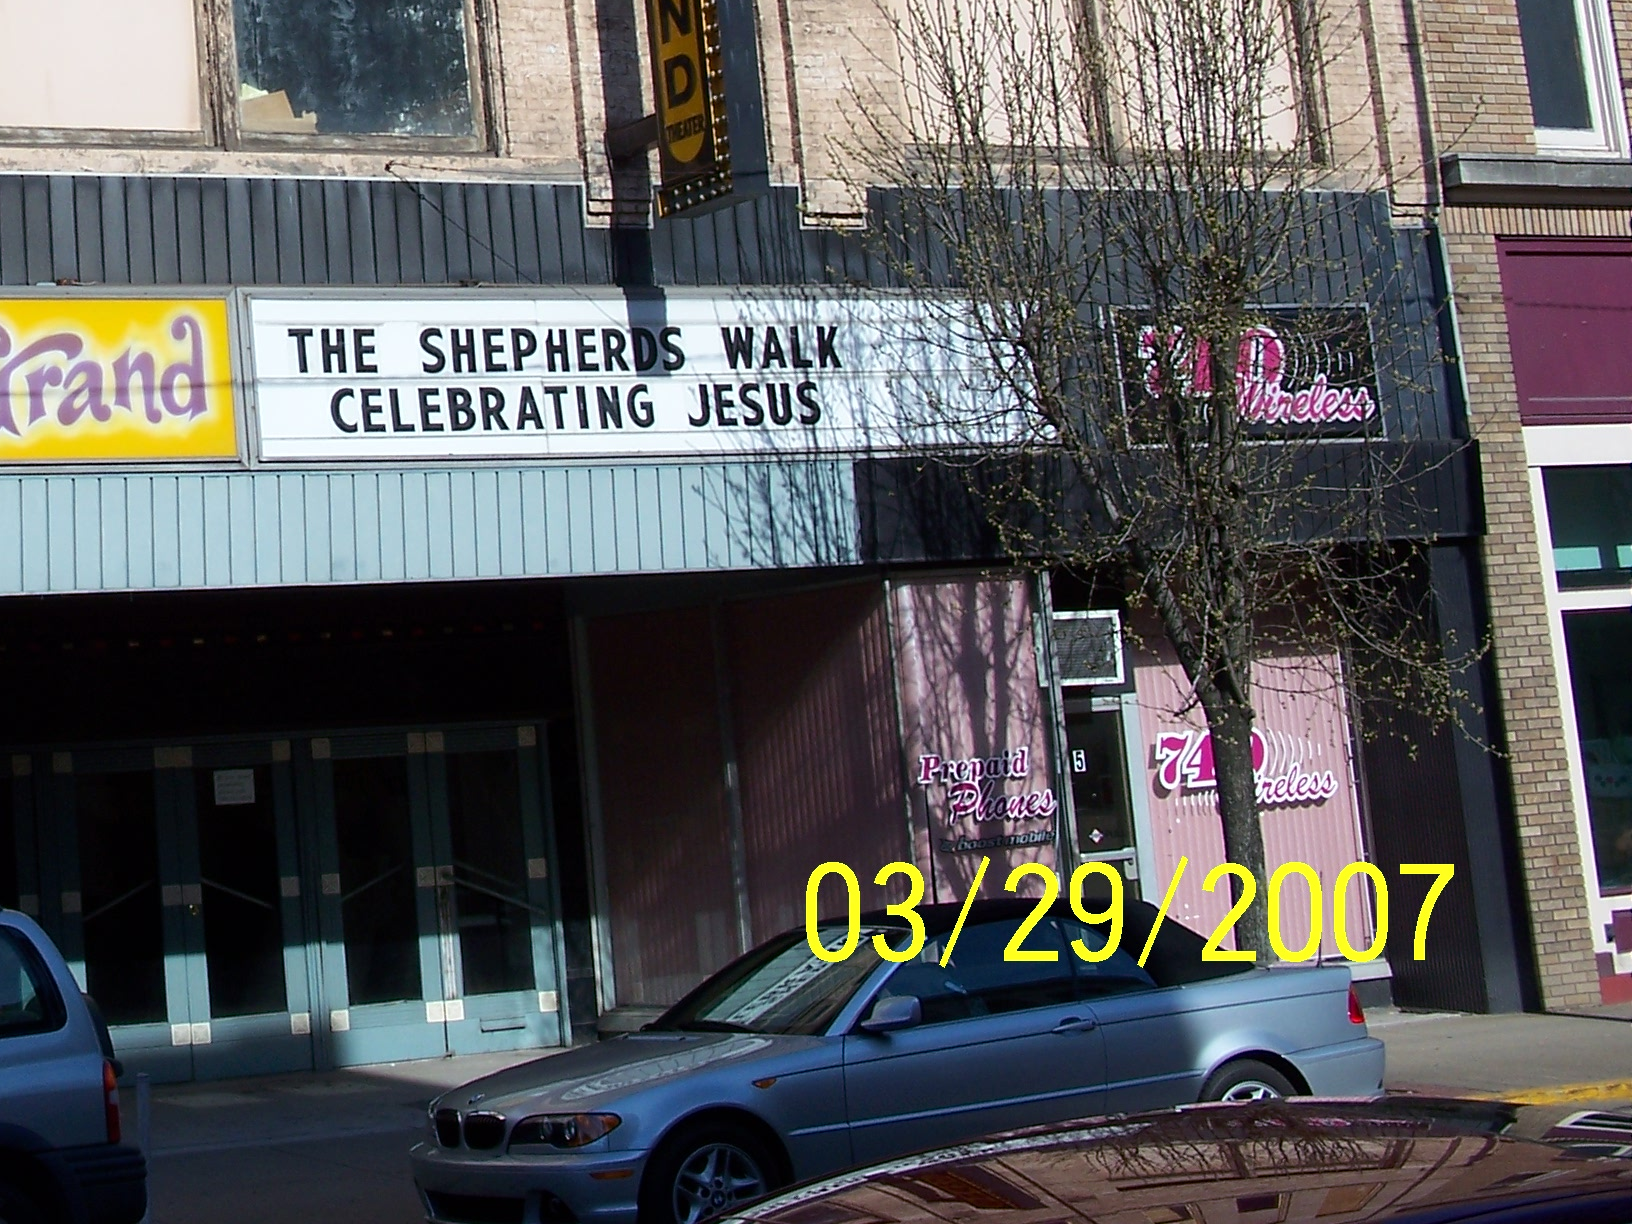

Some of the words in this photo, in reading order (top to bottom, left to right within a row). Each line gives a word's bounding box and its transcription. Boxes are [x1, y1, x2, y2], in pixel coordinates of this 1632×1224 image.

[287, 327, 378, 374] THE
[421, 325, 686, 374] SHEPHERDS
[721, 324, 843, 370] WALK
[329, 383, 655, 434] CELEBRATING
[687, 380, 823, 429] JESUS
[917, 746, 1029, 785] Prepaid
[1256, 761, 1339, 804] ireless
[947, 780, 1058, 827] Phones
